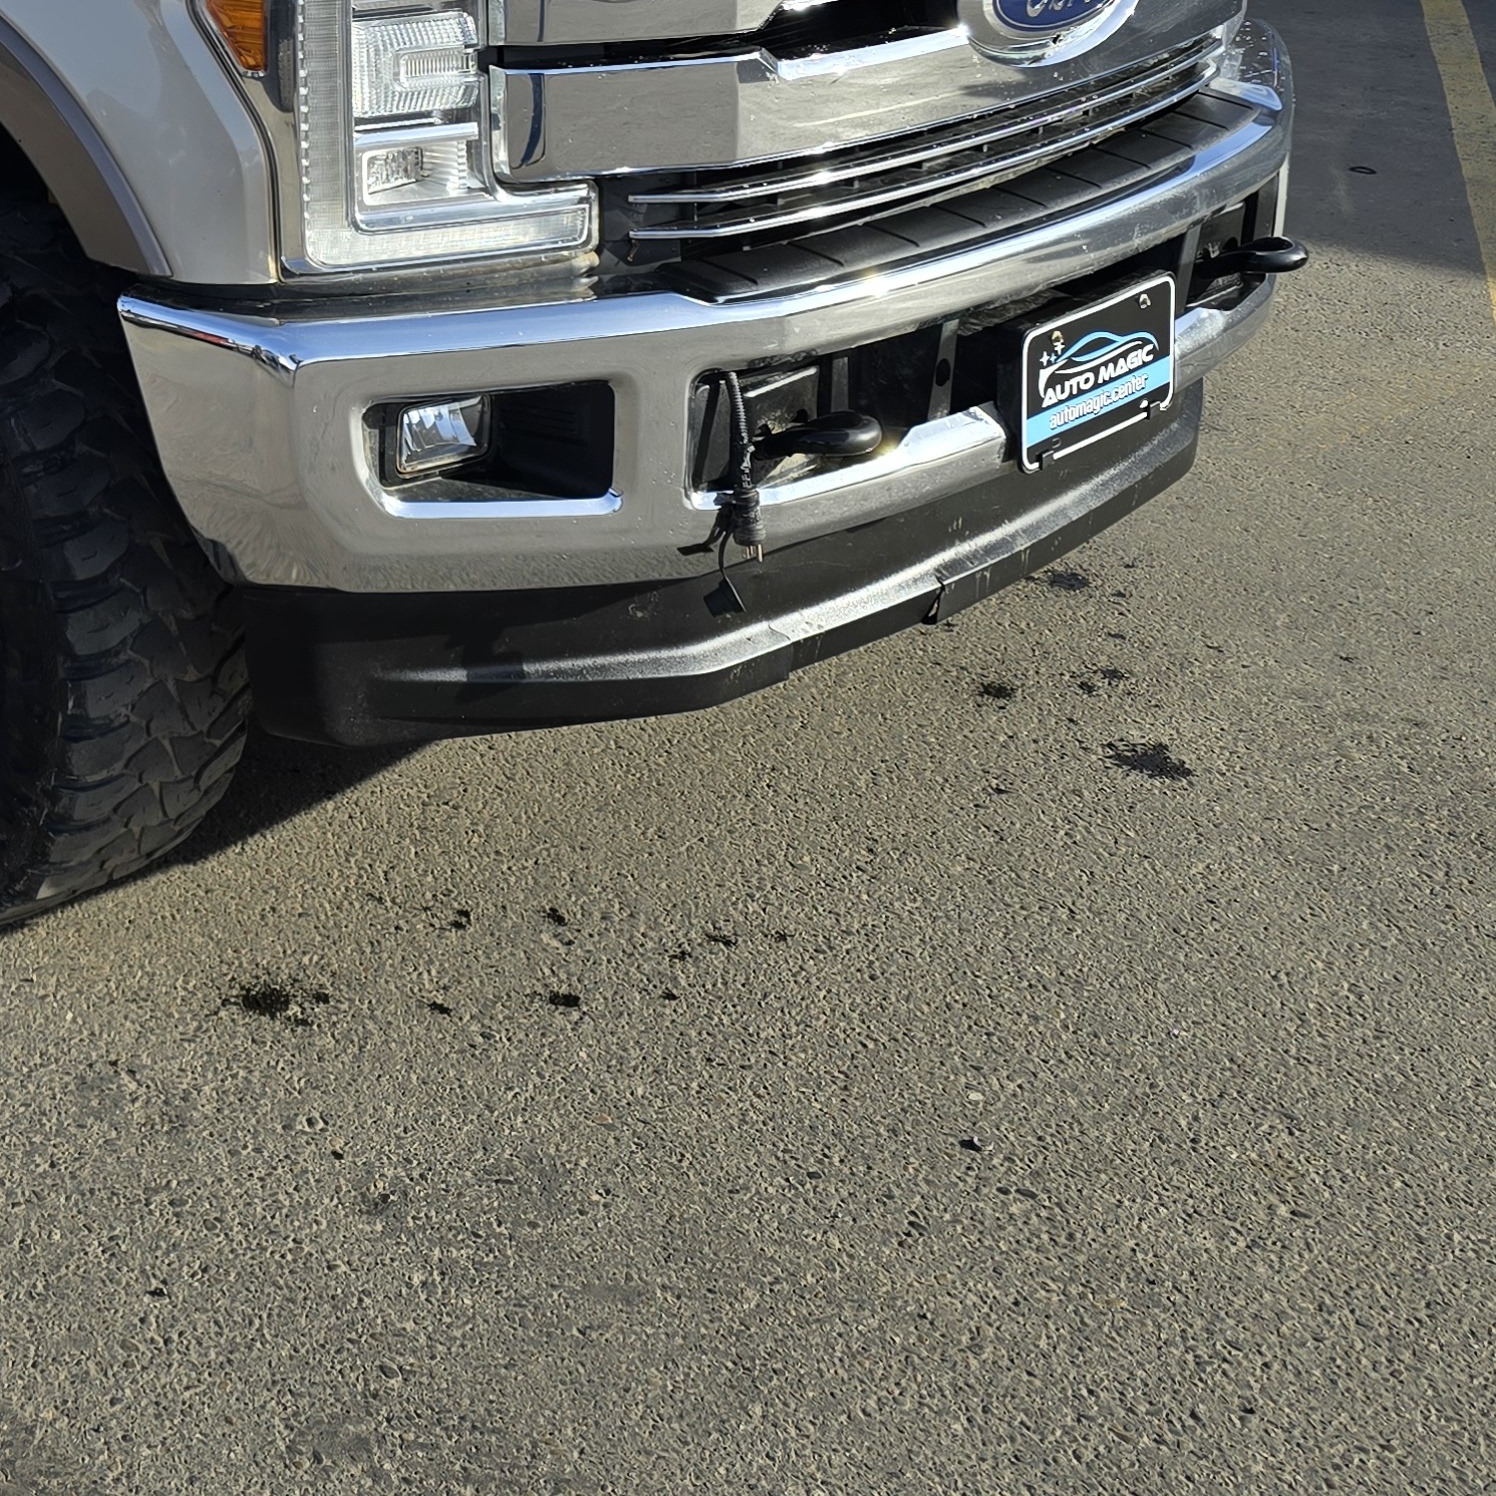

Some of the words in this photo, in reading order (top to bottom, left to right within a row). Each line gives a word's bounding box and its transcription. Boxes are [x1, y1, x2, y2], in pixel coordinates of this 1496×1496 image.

[1041, 372, 1095, 408] AUTO
[1097, 344, 1154, 384] MAGIC
[1050, 373, 1148, 430] automagic.center
